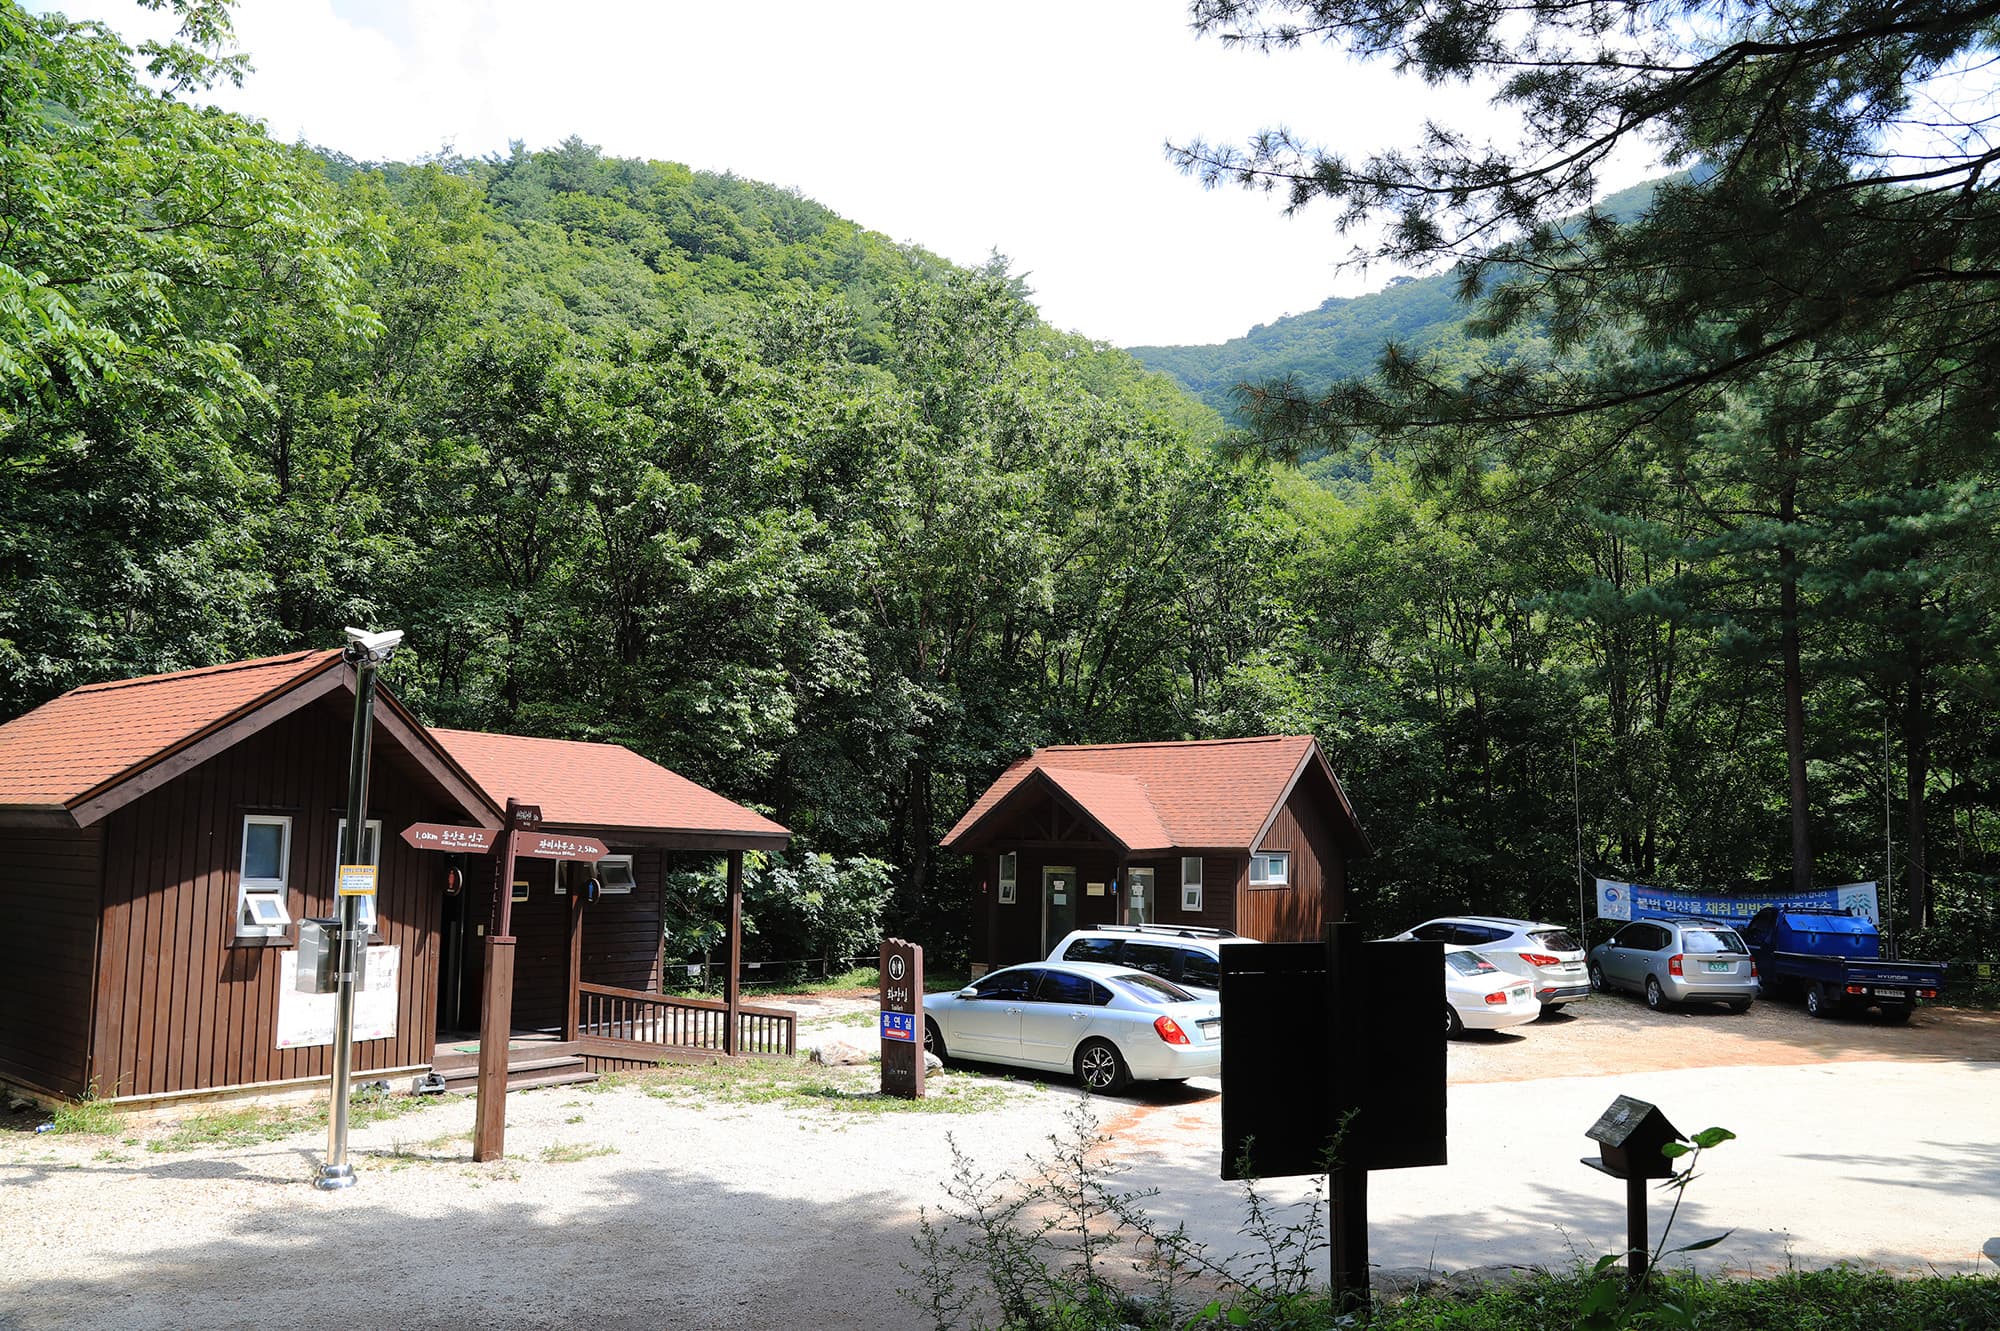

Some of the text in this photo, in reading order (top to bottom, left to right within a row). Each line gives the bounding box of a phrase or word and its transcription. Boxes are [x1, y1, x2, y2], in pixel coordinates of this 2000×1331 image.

[442, 830, 466, 841] 등산로
[539, 839, 575, 851] 관리사무소
[1637, 897, 1661, 911] 불법
[1664, 900, 1702, 914] 임산물
[887, 986, 908, 1002] 화장실
